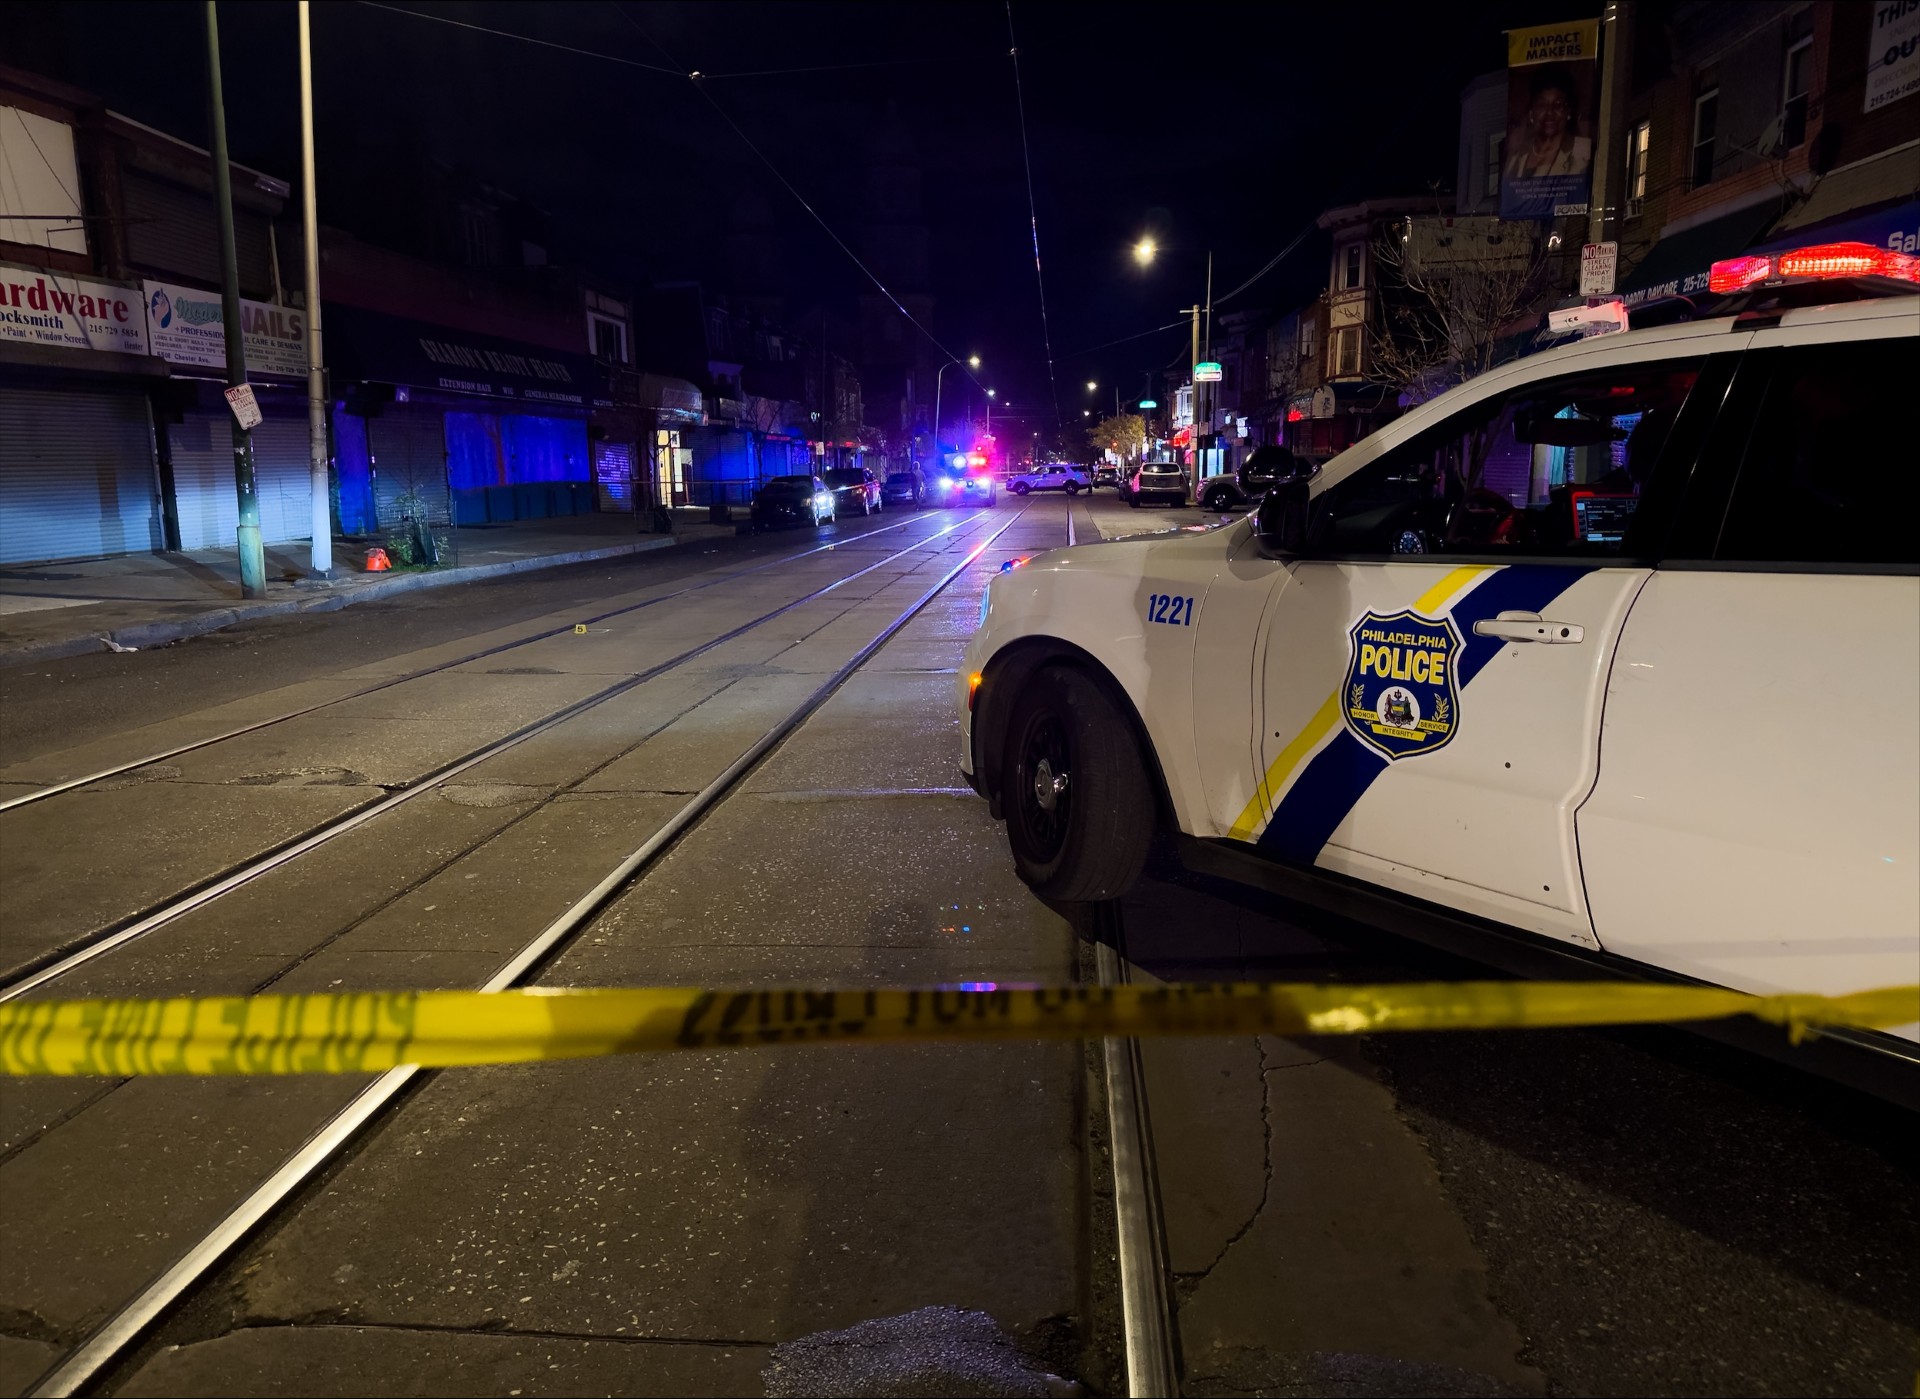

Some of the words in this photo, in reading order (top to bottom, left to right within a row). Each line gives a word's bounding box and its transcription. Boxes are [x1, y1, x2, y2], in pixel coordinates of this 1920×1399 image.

[1529, 32, 1580, 48] IMPACT
[1526, 45, 1582, 60] MAKERS
[1884, 34, 1920, 65] OU
[1584, 246, 1595, 260] NO
[1587, 269, 1610, 277] FRIDAY
[1647, 280, 1679, 300] DAYCARE
[7, 325, 27, 338] Paint
[36, 329, 63, 342] Window
[89, 324, 103, 333] 215
[105, 326, 118, 336] 729
[121, 328, 139, 338] 5854
[252, 337, 269, 346] CARE
[439, 377, 477, 391] EXTENSION
[1148, 594, 1194, 626] 1221
[1361, 630, 1447, 649] PHILADELPHIA
[1360, 644, 1446, 685] POLICE
[1353, 711, 1375, 719] HONOR
[1382, 727, 1415, 738] INTEGRITY
[1420, 721, 1447, 732] SERVICE
